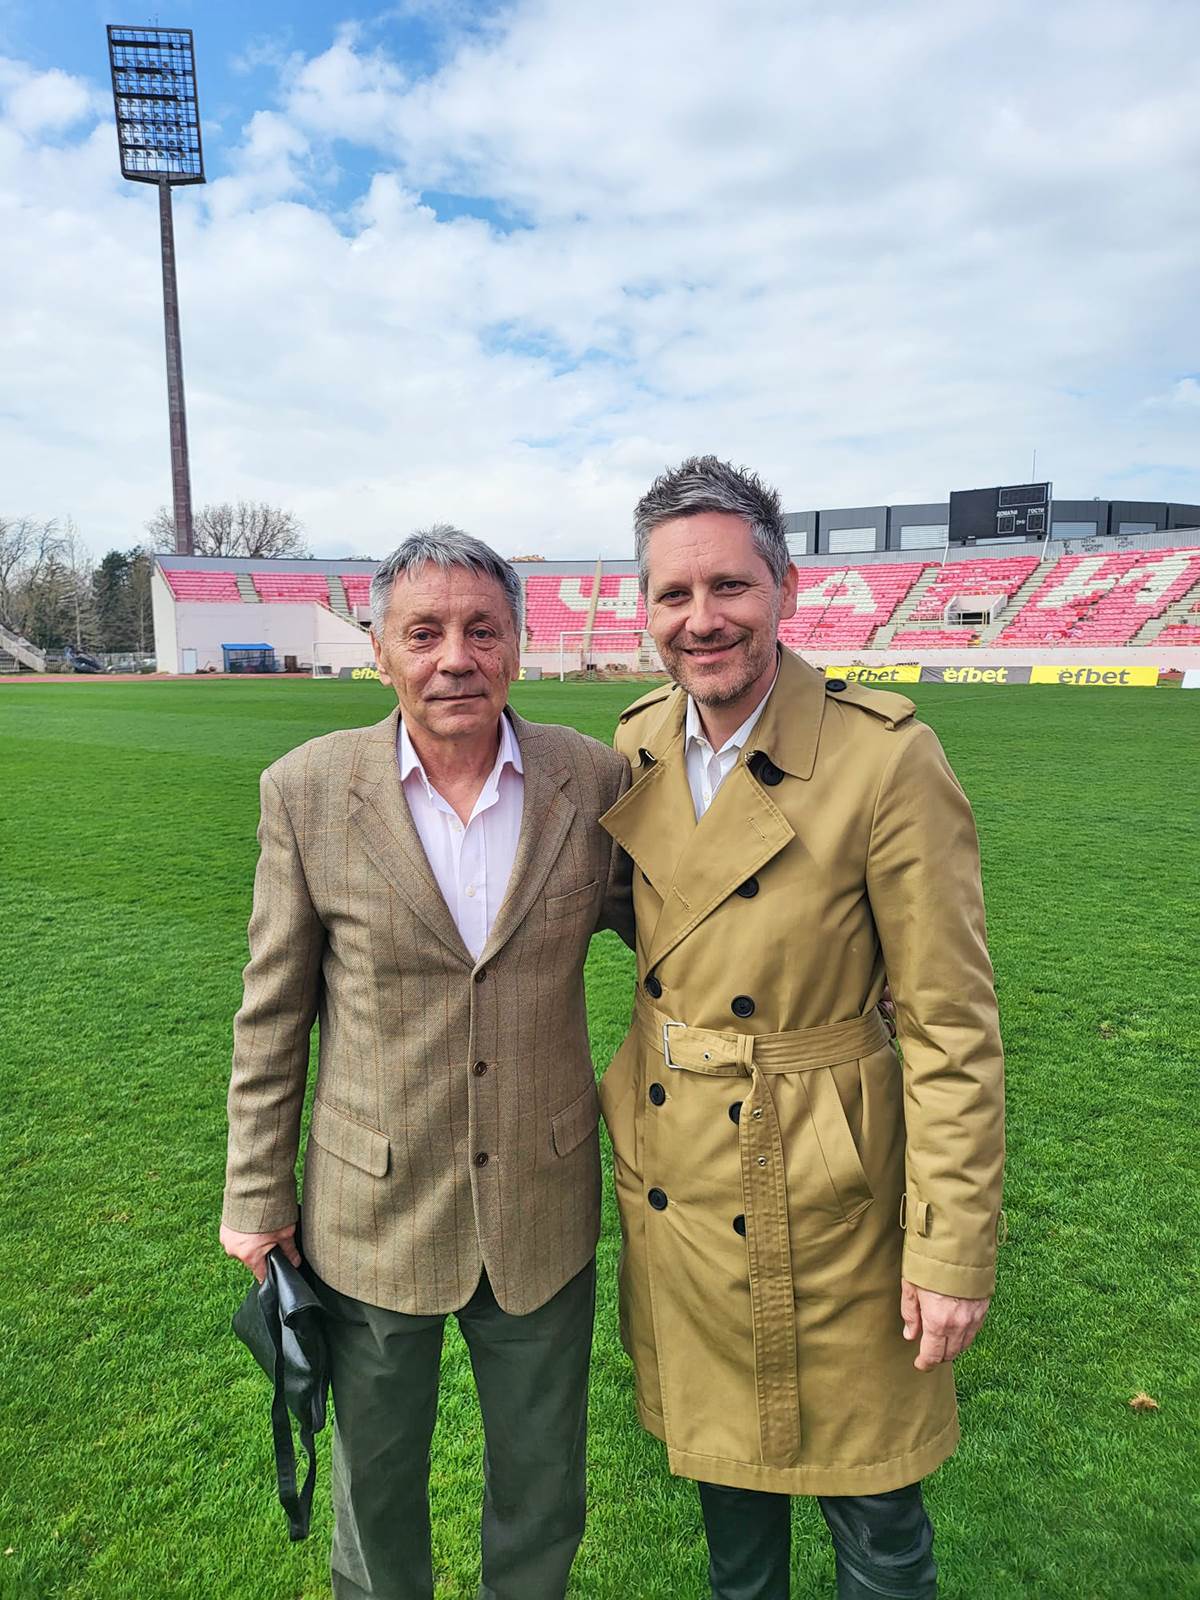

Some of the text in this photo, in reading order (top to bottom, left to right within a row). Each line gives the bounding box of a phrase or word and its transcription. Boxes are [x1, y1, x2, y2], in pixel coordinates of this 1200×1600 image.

[352, 668, 380, 680] efbe
[847, 669, 899, 681] efbet
[943, 667, 1008, 683] efbet
[1058, 668, 1129, 684] efbet
